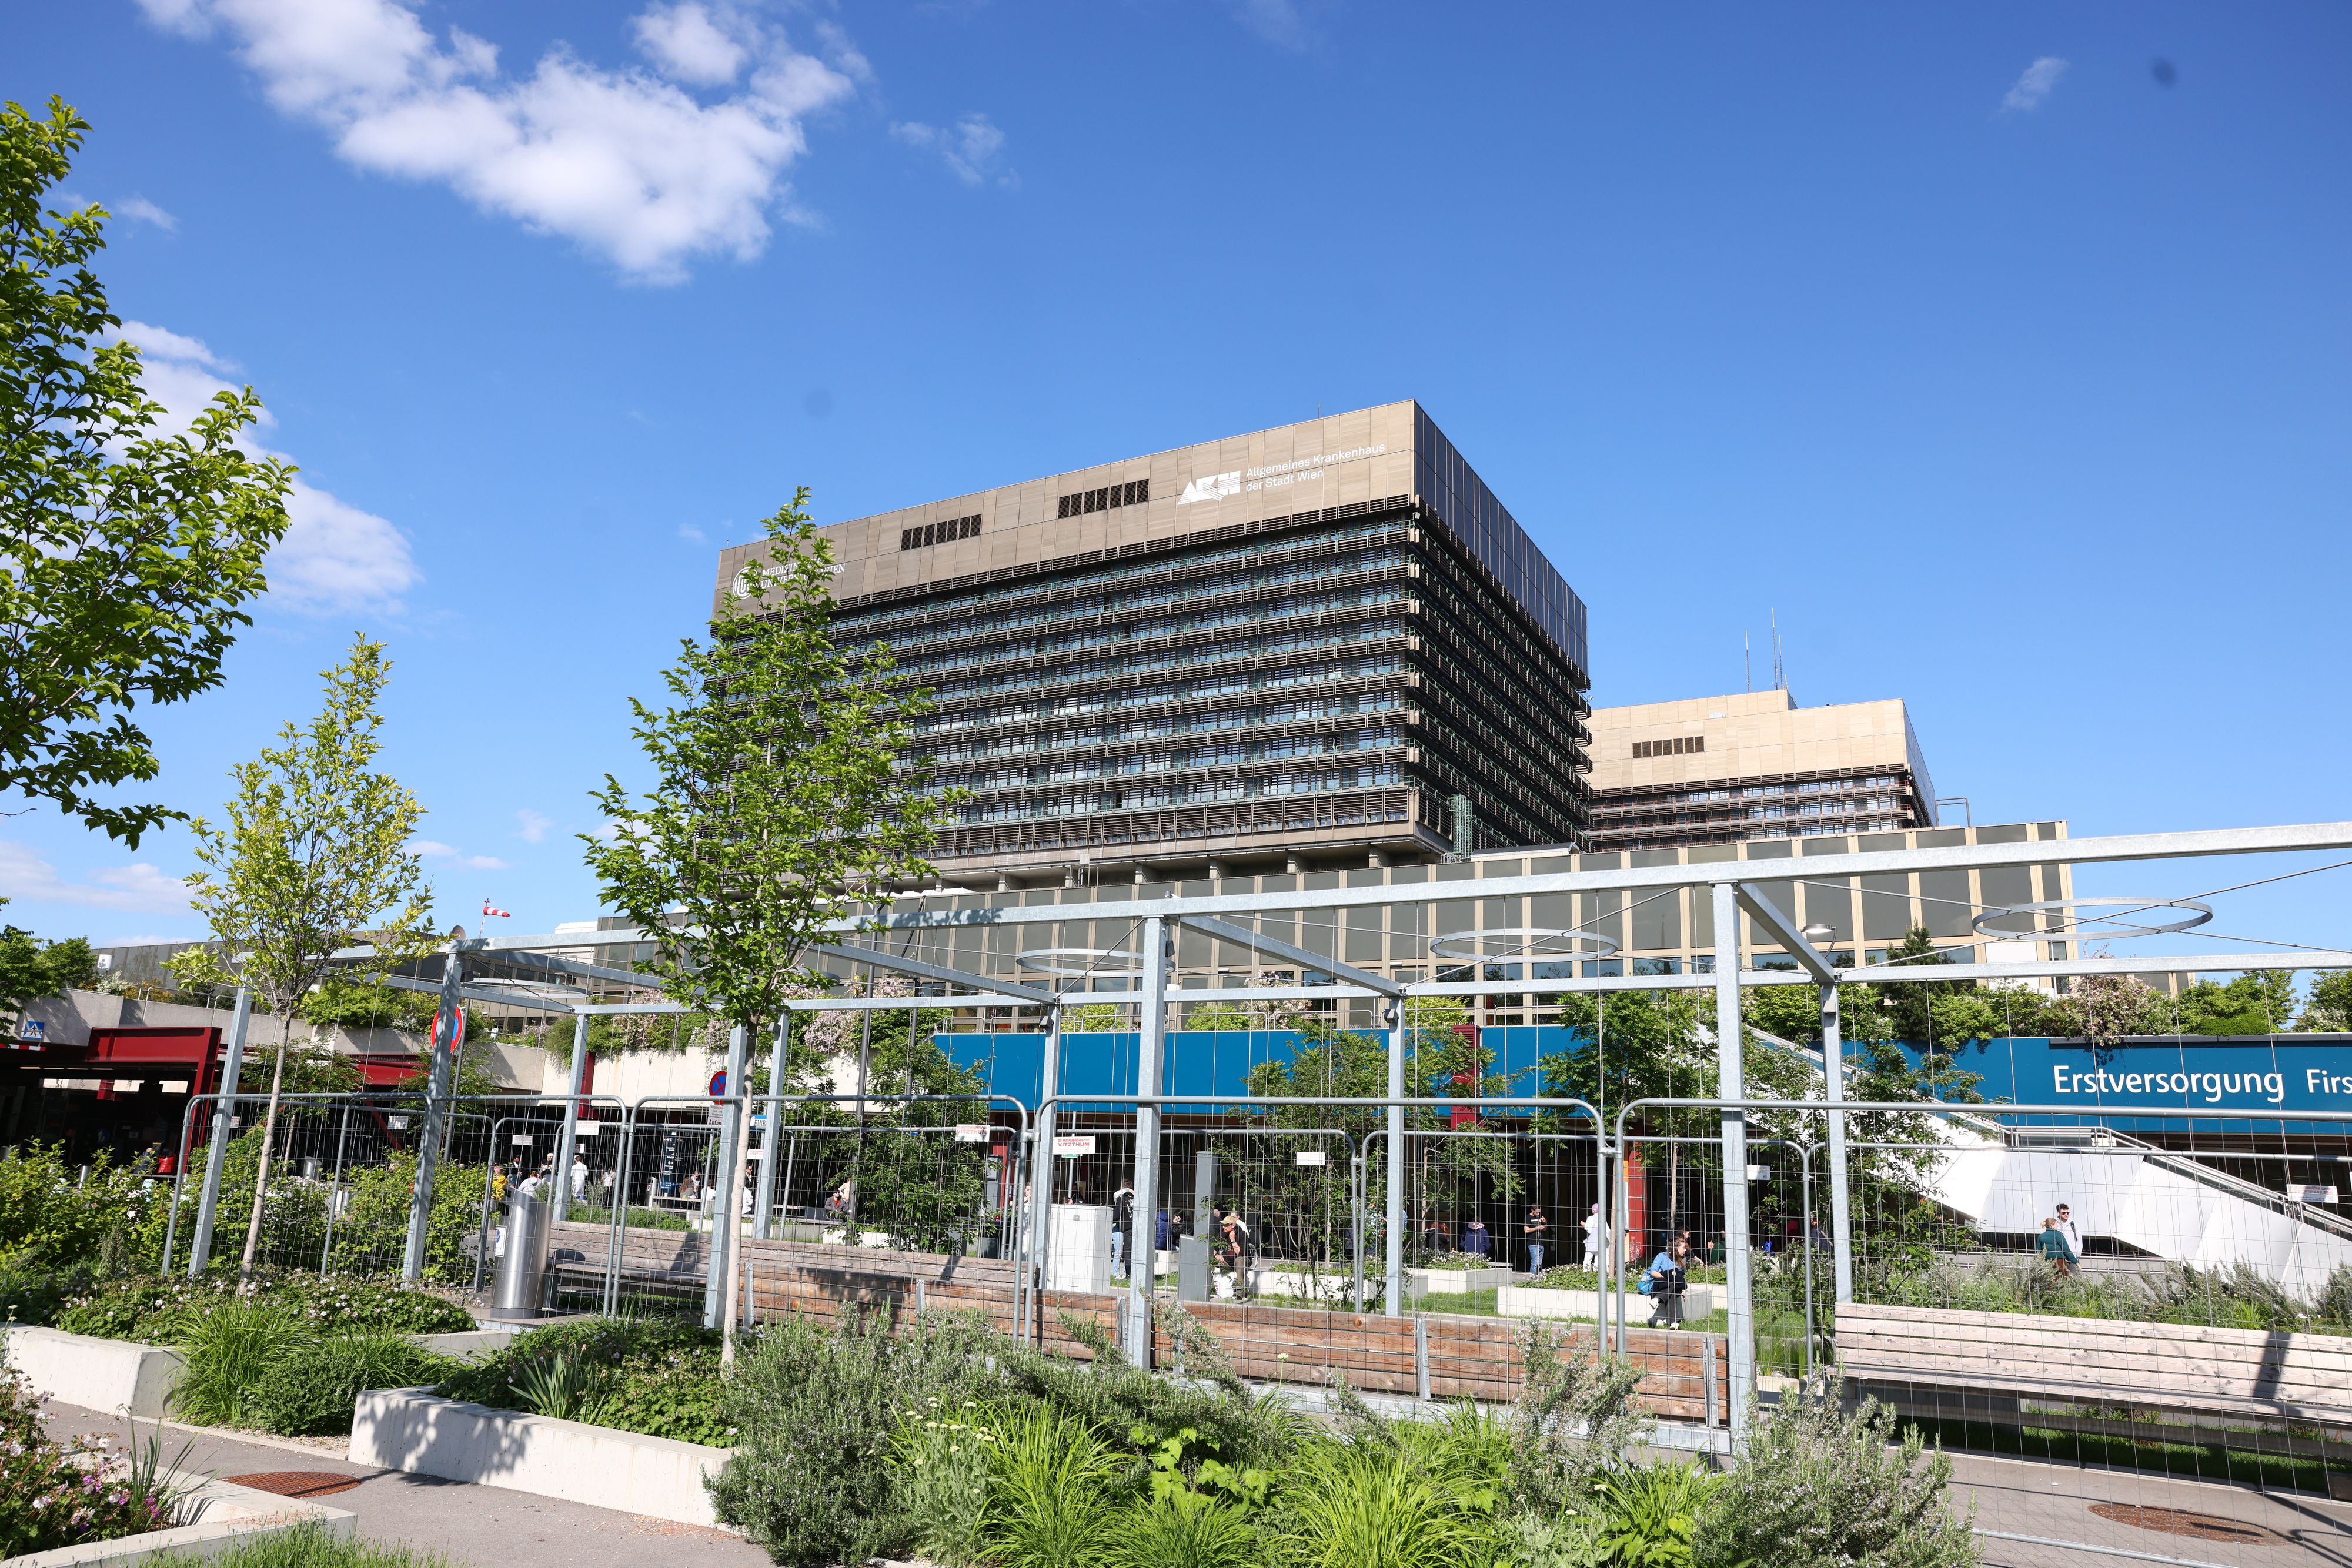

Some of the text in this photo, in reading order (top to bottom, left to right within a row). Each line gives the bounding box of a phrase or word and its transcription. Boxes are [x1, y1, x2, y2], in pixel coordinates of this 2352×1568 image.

[1246, 444, 1385, 477] Allgemeines Krankenhaus
[1246, 469, 1324, 492] der Stadt Wien
[2053, 1065, 2284, 1102] Erstversorgung
